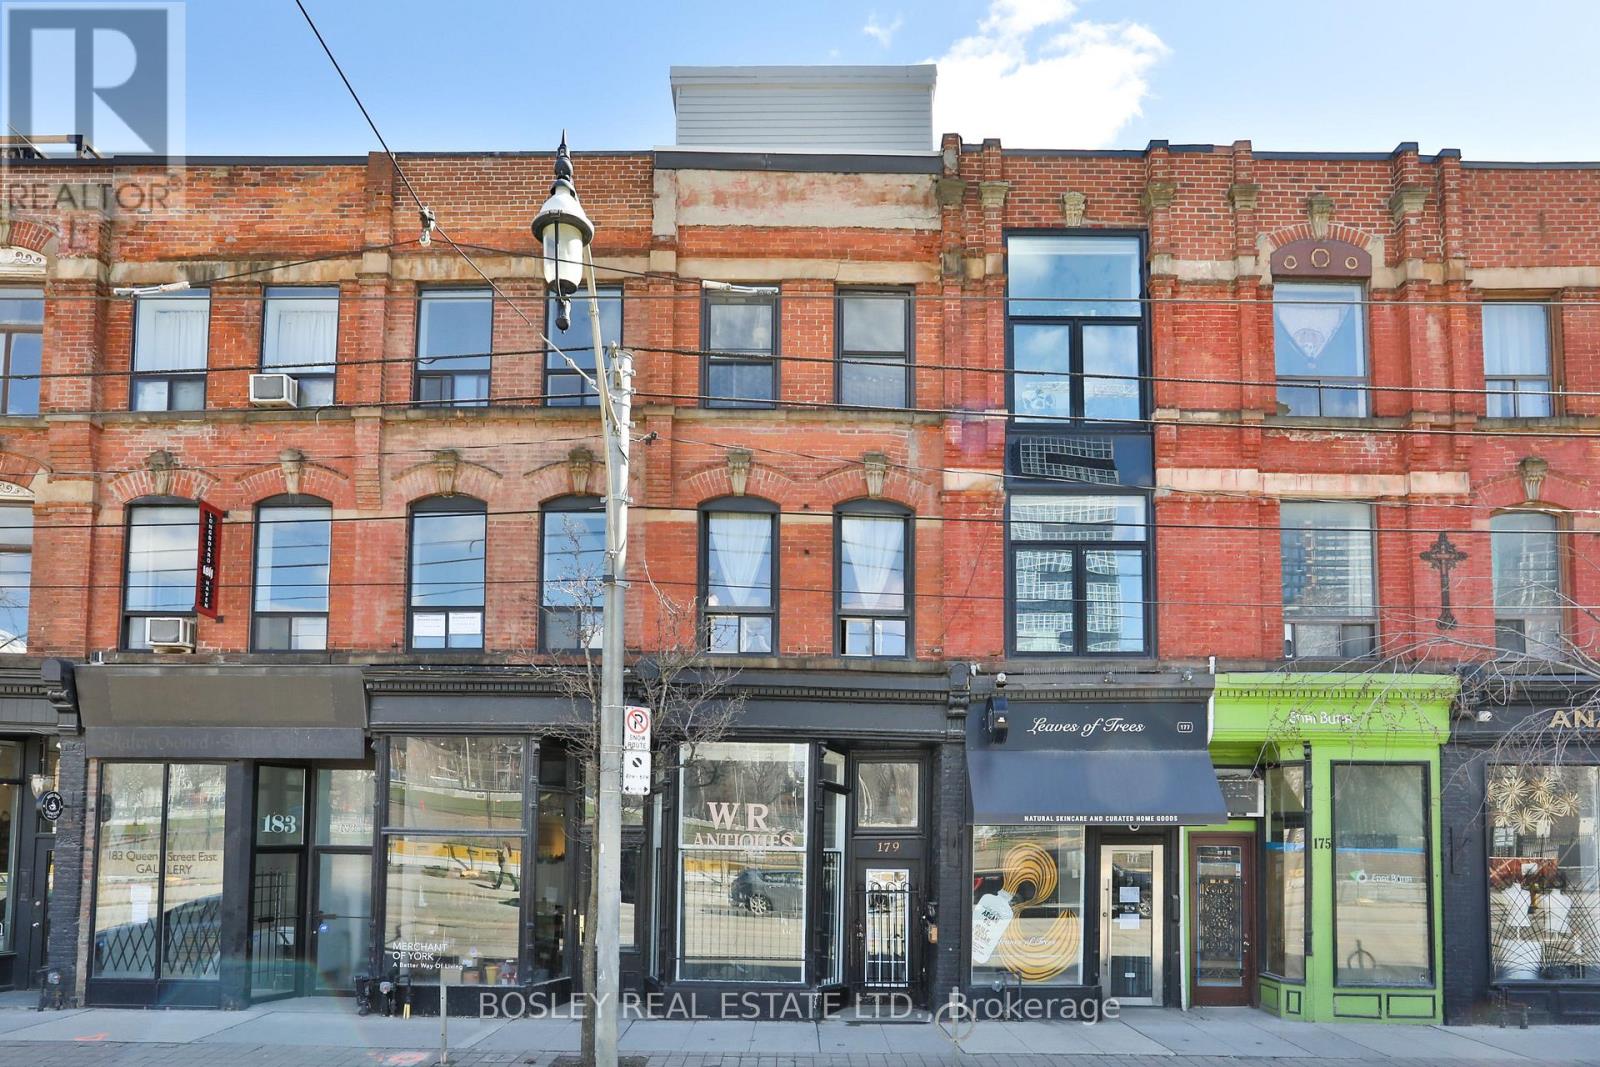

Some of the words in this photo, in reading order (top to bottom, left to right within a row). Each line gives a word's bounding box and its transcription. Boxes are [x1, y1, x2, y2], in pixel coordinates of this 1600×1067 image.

[1549, 710, 1600, 728] AN
[1027, 717, 1080, 735] Leaves
[1081, 718, 1103, 737] of
[1103, 717, 1145, 732] Trees
[628, 741, 647, 749] ROUTE
[261, 814, 297, 834] 183
[694, 832, 796, 850] ANTIQUES
[877, 841, 900, 853] 179
[1314, 837, 1331, 849] 175
[108, 850, 123, 861] 183
[126, 850, 159, 862] Queen
[167, 851, 197, 861] Street
[198, 851, 218, 861] East
[392, 942, 448, 951] MERCHANT
[392, 952, 406, 960] OF
[408, 952, 434, 961] YORK
[420, 962, 433, 970] Way
